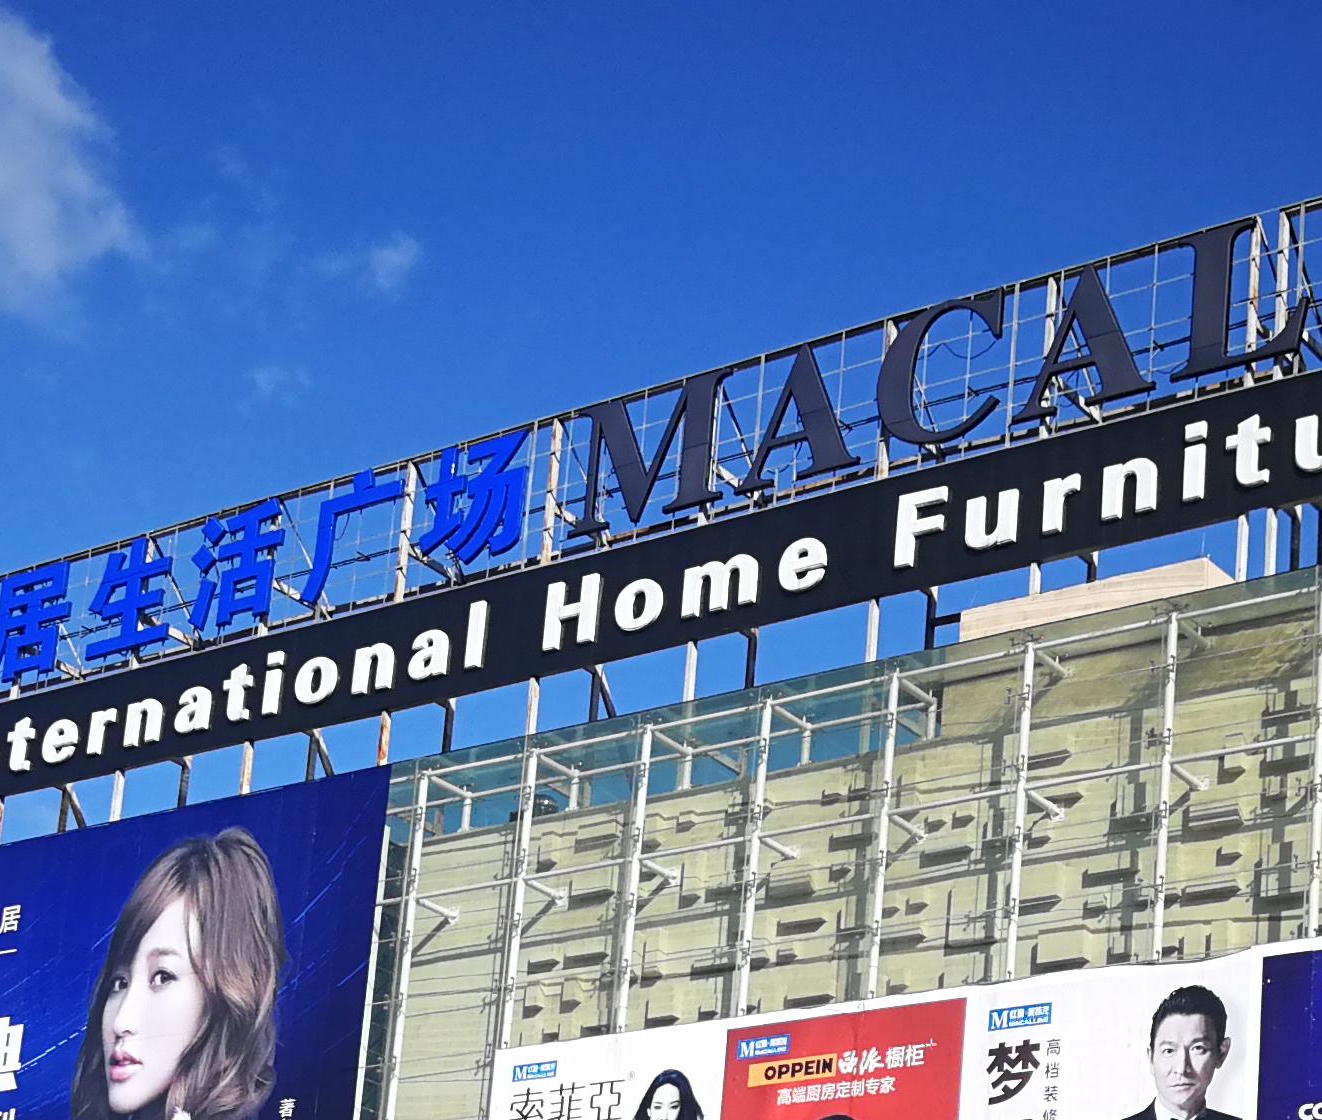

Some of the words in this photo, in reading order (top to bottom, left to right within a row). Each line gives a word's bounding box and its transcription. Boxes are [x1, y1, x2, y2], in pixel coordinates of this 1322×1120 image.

[542, 536, 828, 652] Home
[764, 1058, 834, 1081] OPPEIN
[777, 1076, 895, 1106] 高端厨房定制专家
